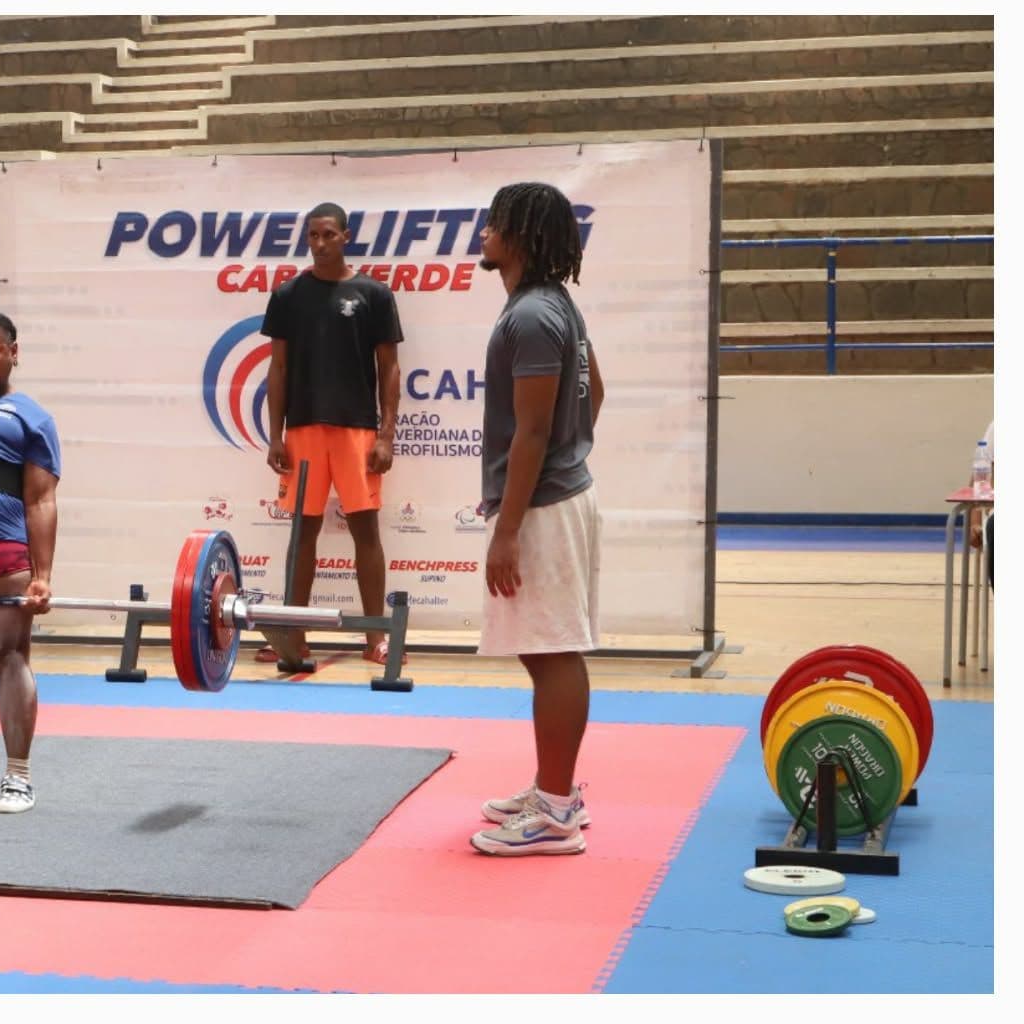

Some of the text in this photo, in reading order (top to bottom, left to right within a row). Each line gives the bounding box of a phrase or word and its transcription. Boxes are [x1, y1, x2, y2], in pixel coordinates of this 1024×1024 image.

[104, 205, 594, 258] POWELIFTI
[217, 264, 298, 293] CAB
[406, 369, 485, 401] CAH
[395, 410, 440, 429] RAÇÃO
[395, 429, 469, 442] VERDIANA
[392, 444, 483, 457] EROFILISMO
[239, 556, 270, 566] UAT
[389, 560, 478, 572] BENCHPRESS
[420, 575, 446, 583] SUPINO
[313, 593, 354, 605] gmail.com
[812, 743, 829, 760] 10
